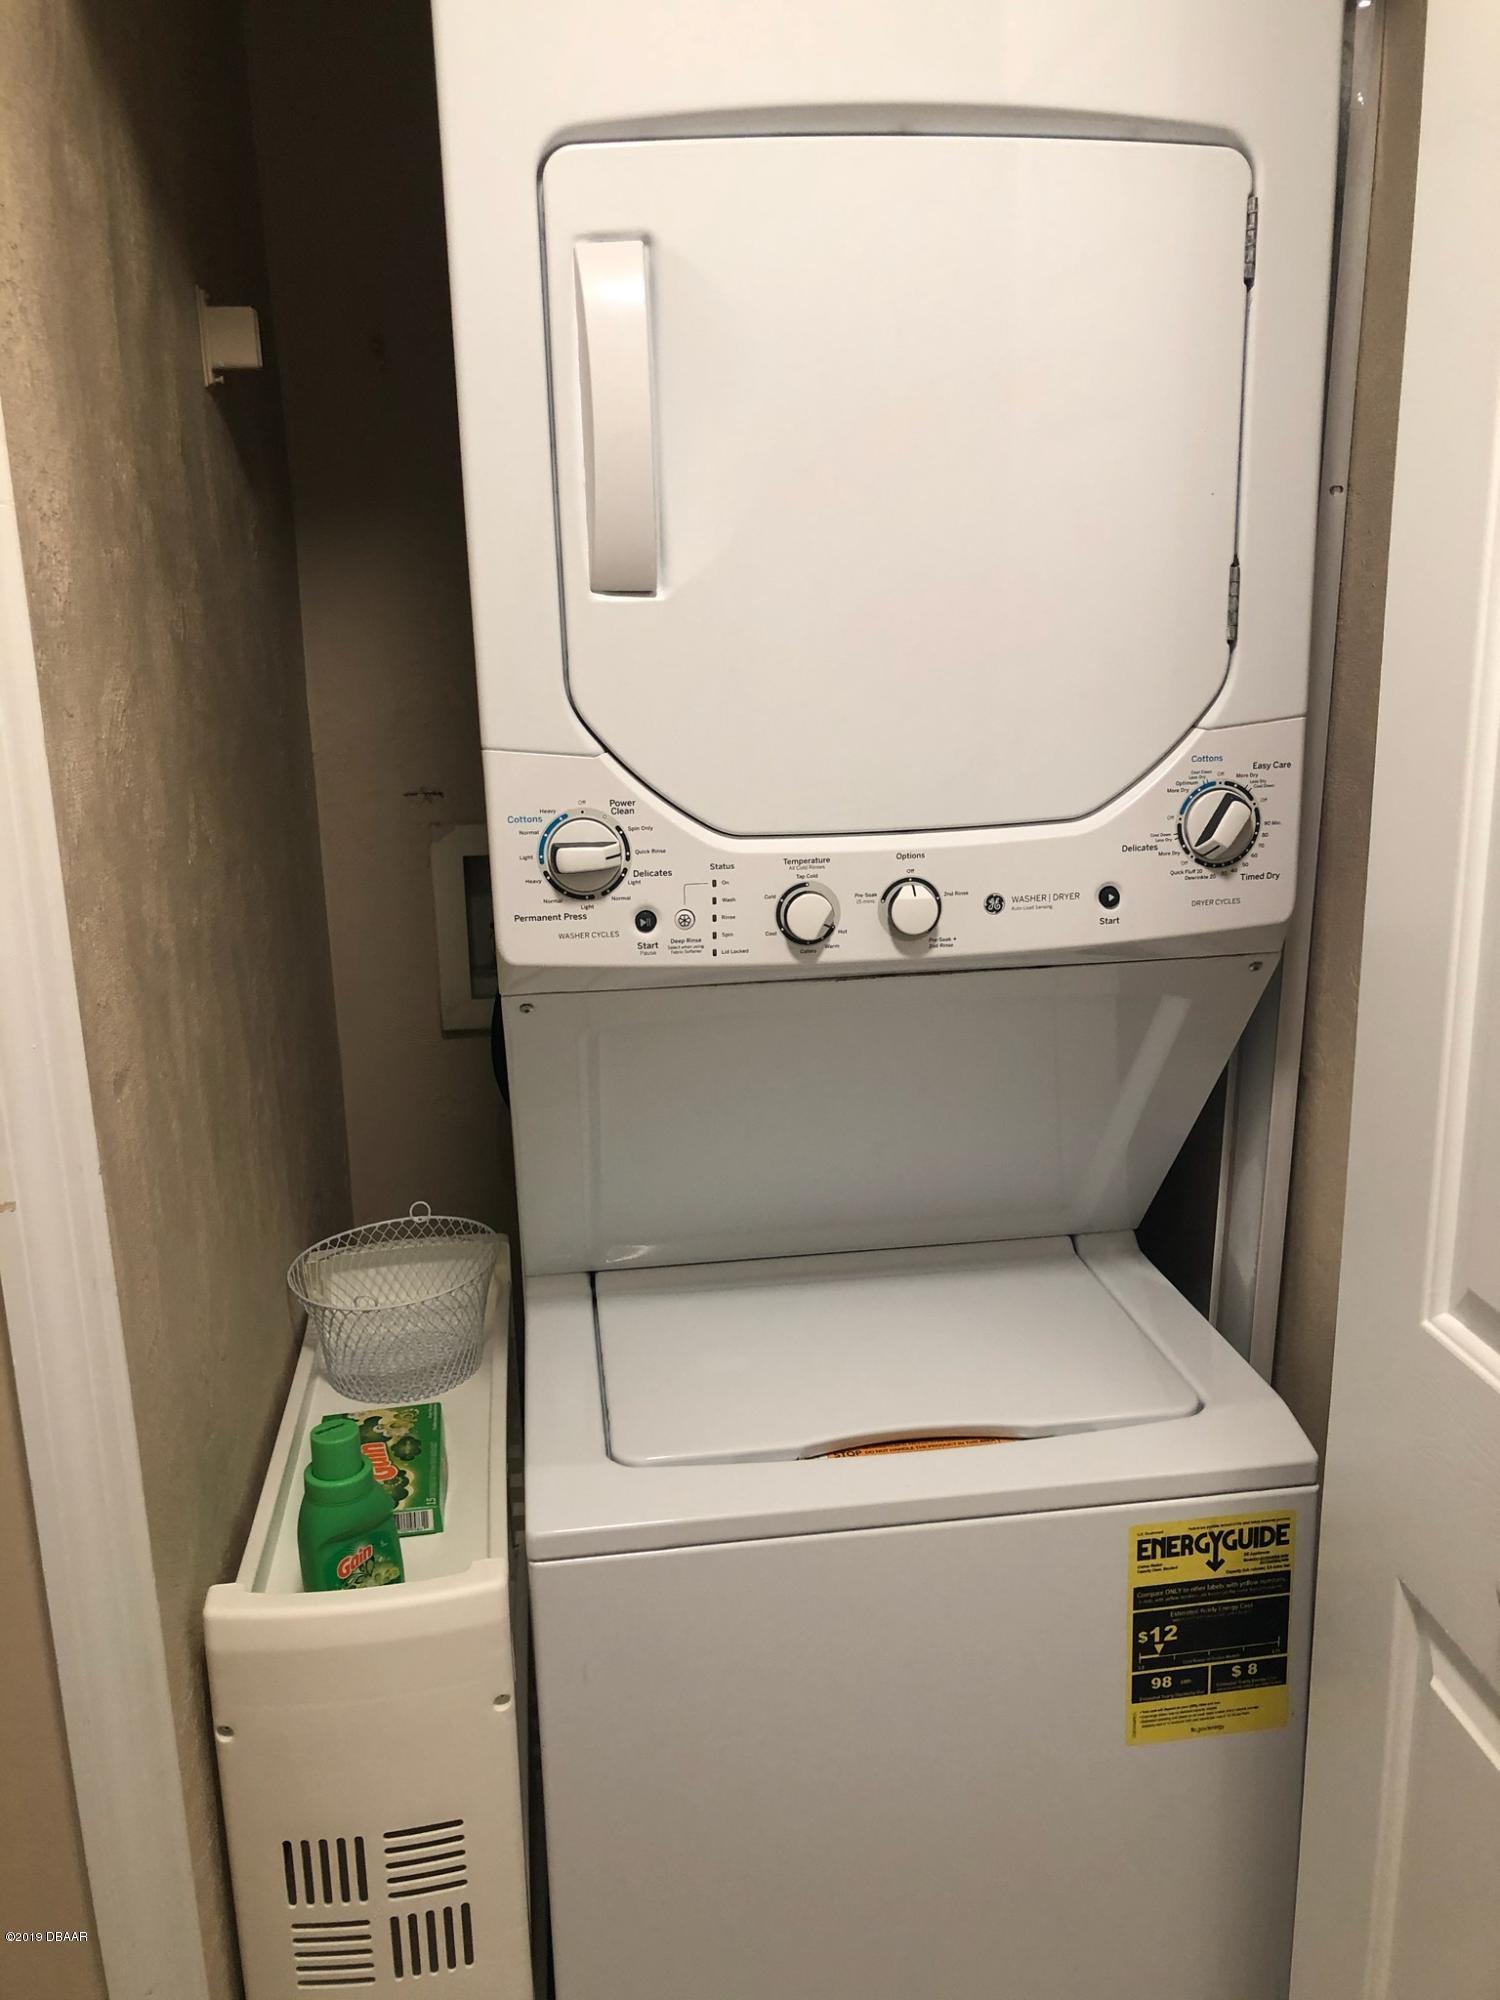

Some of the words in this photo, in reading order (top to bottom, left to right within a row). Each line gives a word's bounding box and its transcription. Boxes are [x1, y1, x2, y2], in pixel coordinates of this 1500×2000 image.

[1191, 755, 1223, 763] Cottons
[1252, 762, 1270, 770] Easy
[611, 807, 635, 815] Clean
[507, 815, 543, 824] Cottons
[1122, 844, 1158, 853] Delicates
[896, 852, 925, 860] Options
[783, 857, 831, 866] Temperature
[633, 869, 673, 878] Delicates
[1240, 873, 1265, 881] Timed
[1266, 872, 1280, 880] Dry
[1011, 895, 1047, 903] WASHER
[1053, 892, 1081, 901] DRYER
[514, 913, 561, 922] Permanent
[563, 912, 588, 921] Press
[1099, 917, 1120, 925] Start
[558, 932, 590, 940] WASHER
[591, 931, 620, 939] CYCLES
[637, 942, 659, 950] Start
[1137, 1523, 1290, 1562] ENERGYGUIDE
[337, 1544, 373, 1580] Gain
[1138, 1624, 1178, 1644] $12
[1151, 1676, 1172, 1689] 98
